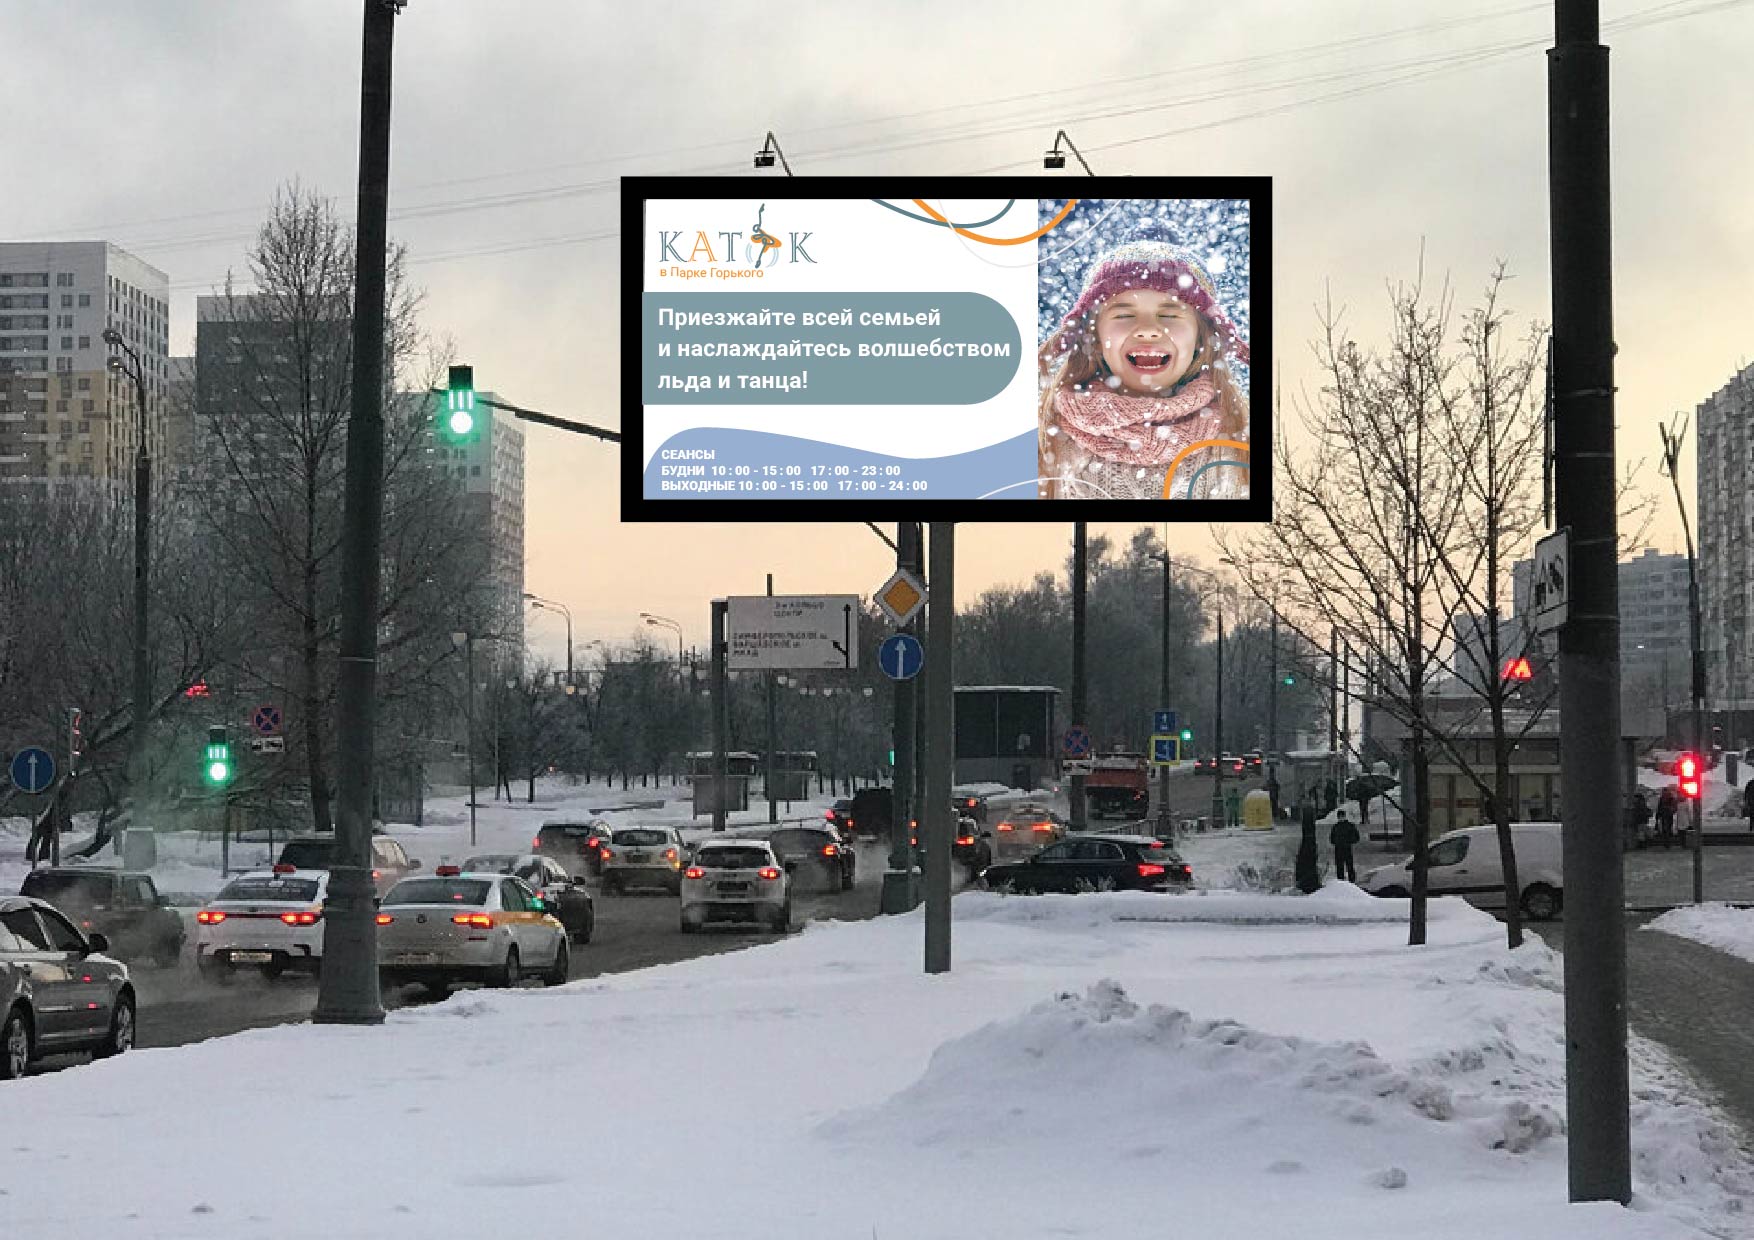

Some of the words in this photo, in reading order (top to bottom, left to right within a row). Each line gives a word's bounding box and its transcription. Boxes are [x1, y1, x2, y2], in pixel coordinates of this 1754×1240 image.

[659, 268, 668, 277] в
[670, 266, 708, 281] Парке
[710, 267, 764, 281] Горького
[658, 307, 796, 331] Приезжайте
[802, 308, 853, 326] всей
[859, 308, 941, 326] семьей
[658, 343, 671, 357] и
[677, 339, 852, 361] наслаждайтесь
[858, 337, 1011, 357] волшебством
[657, 374, 712, 393] льда
[718, 375, 731, 389] и
[736, 370, 808, 393] танца!
[661, 449, 715, 460] СЕАНСЫ
[661, 465, 705, 478] БУДНИ
[661, 480, 736, 493] ВЫХОДНЫЕ
